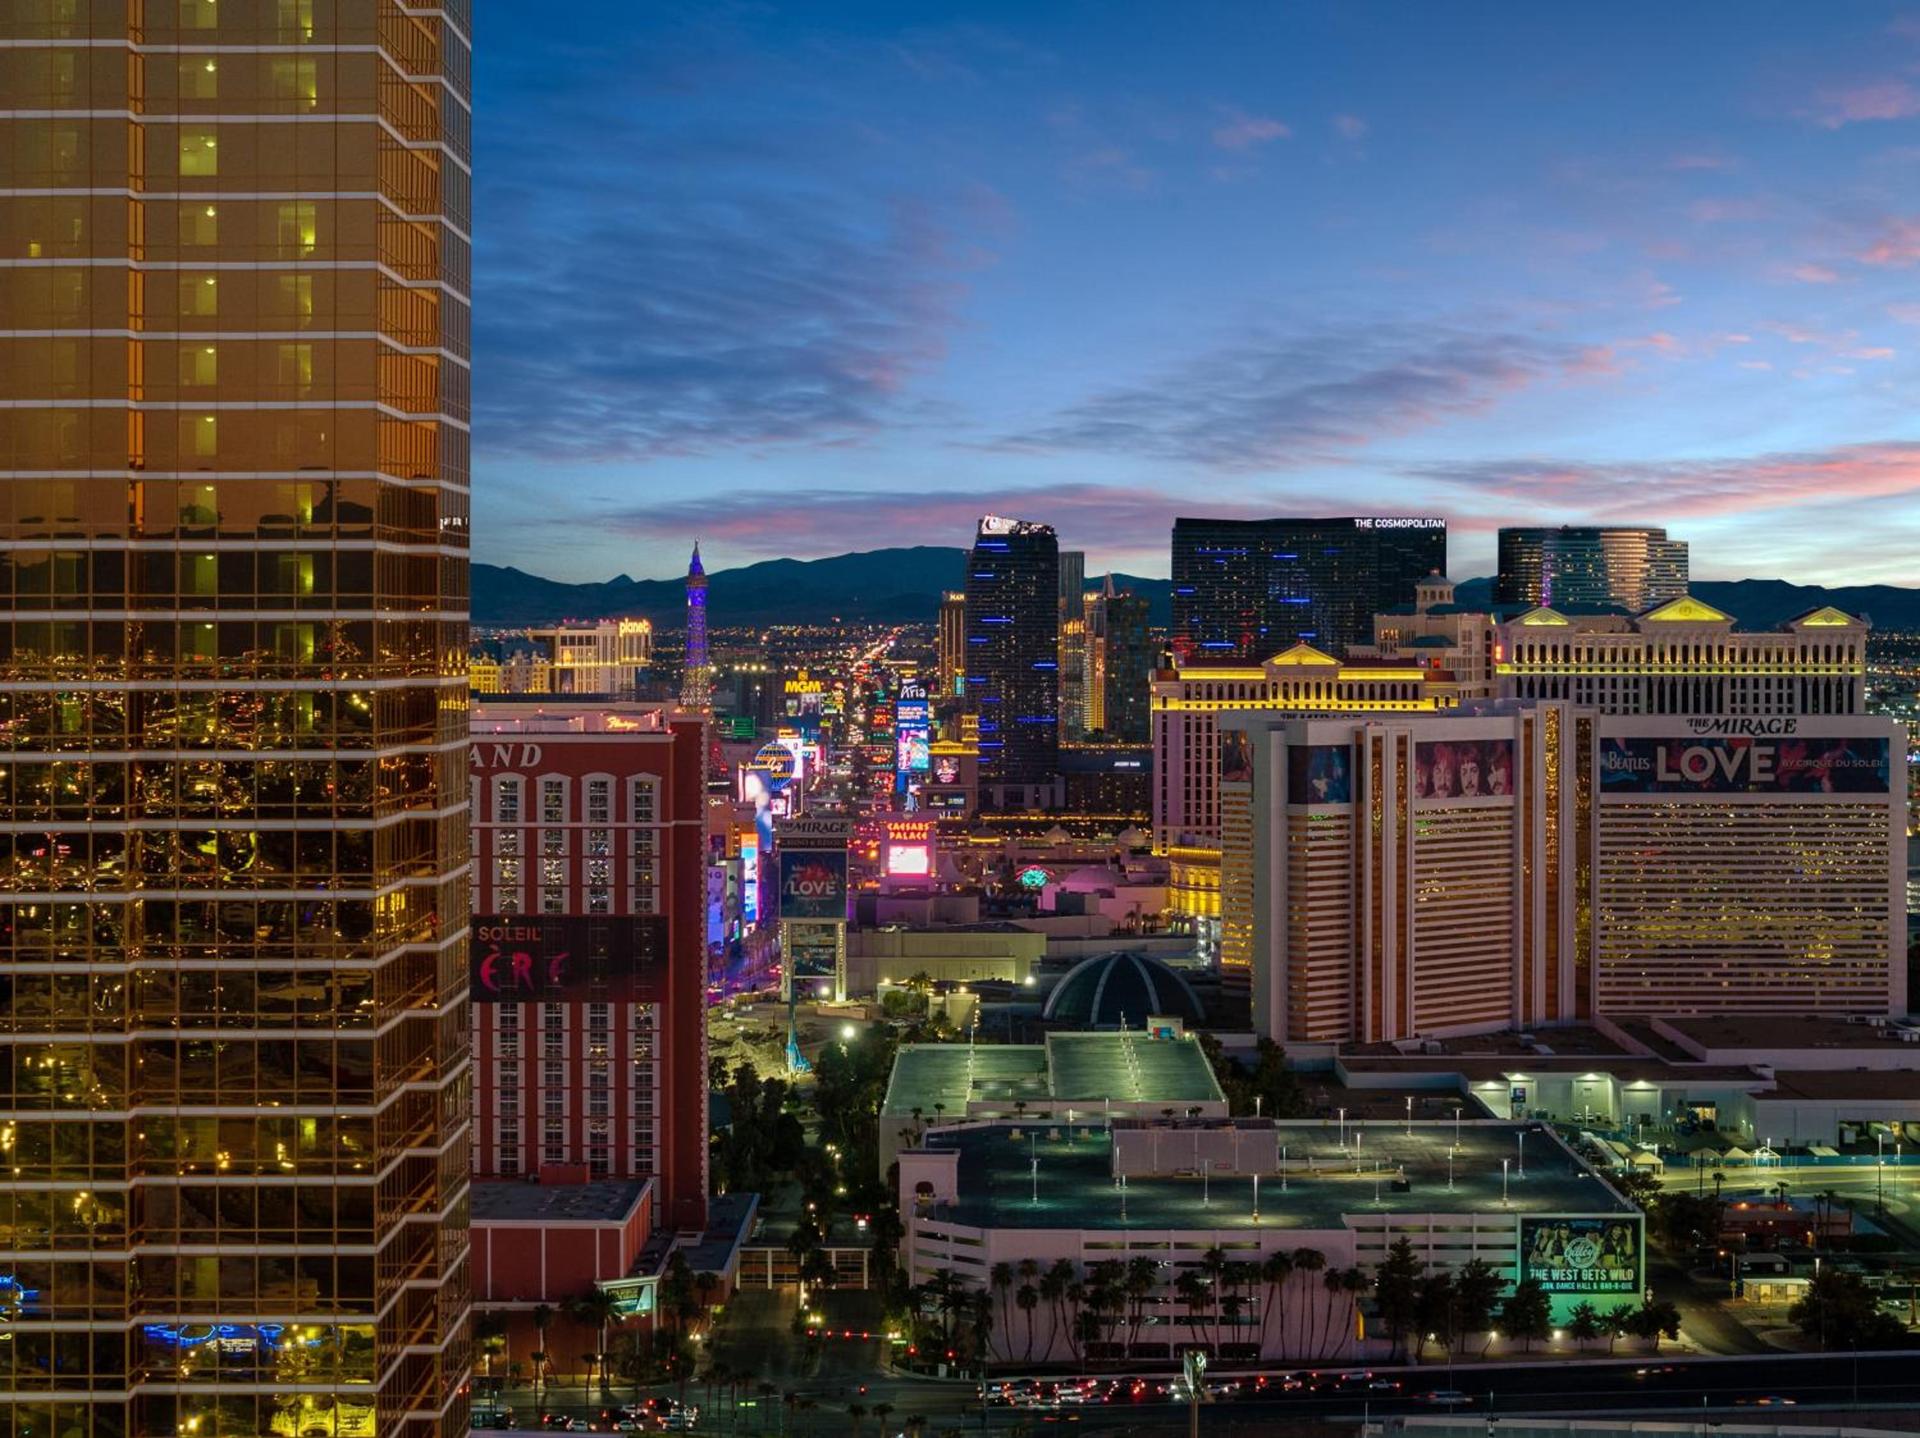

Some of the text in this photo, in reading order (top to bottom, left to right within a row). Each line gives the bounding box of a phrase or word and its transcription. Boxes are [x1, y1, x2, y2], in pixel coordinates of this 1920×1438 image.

[1354, 518, 1446, 529] THE COSMOPOLITAN
[619, 618, 651, 637] planet
[784, 680, 821, 693] MGM
[1687, 717, 1797, 736] THE MIRAGE
[1656, 745, 1776, 783] LOVE
[1796, 760, 1832, 770] CIRQUE
[1836, 760, 1850, 768] DU
[784, 821, 848, 833] MIRAGE
[886, 822, 929, 831] CAESARS
[889, 832, 927, 840] PALACE
[790, 881, 837, 895] LOVE
[478, 926, 541, 941] SOLEIL
[1530, 1268, 1635, 1281] THE WEST GETS WILD
